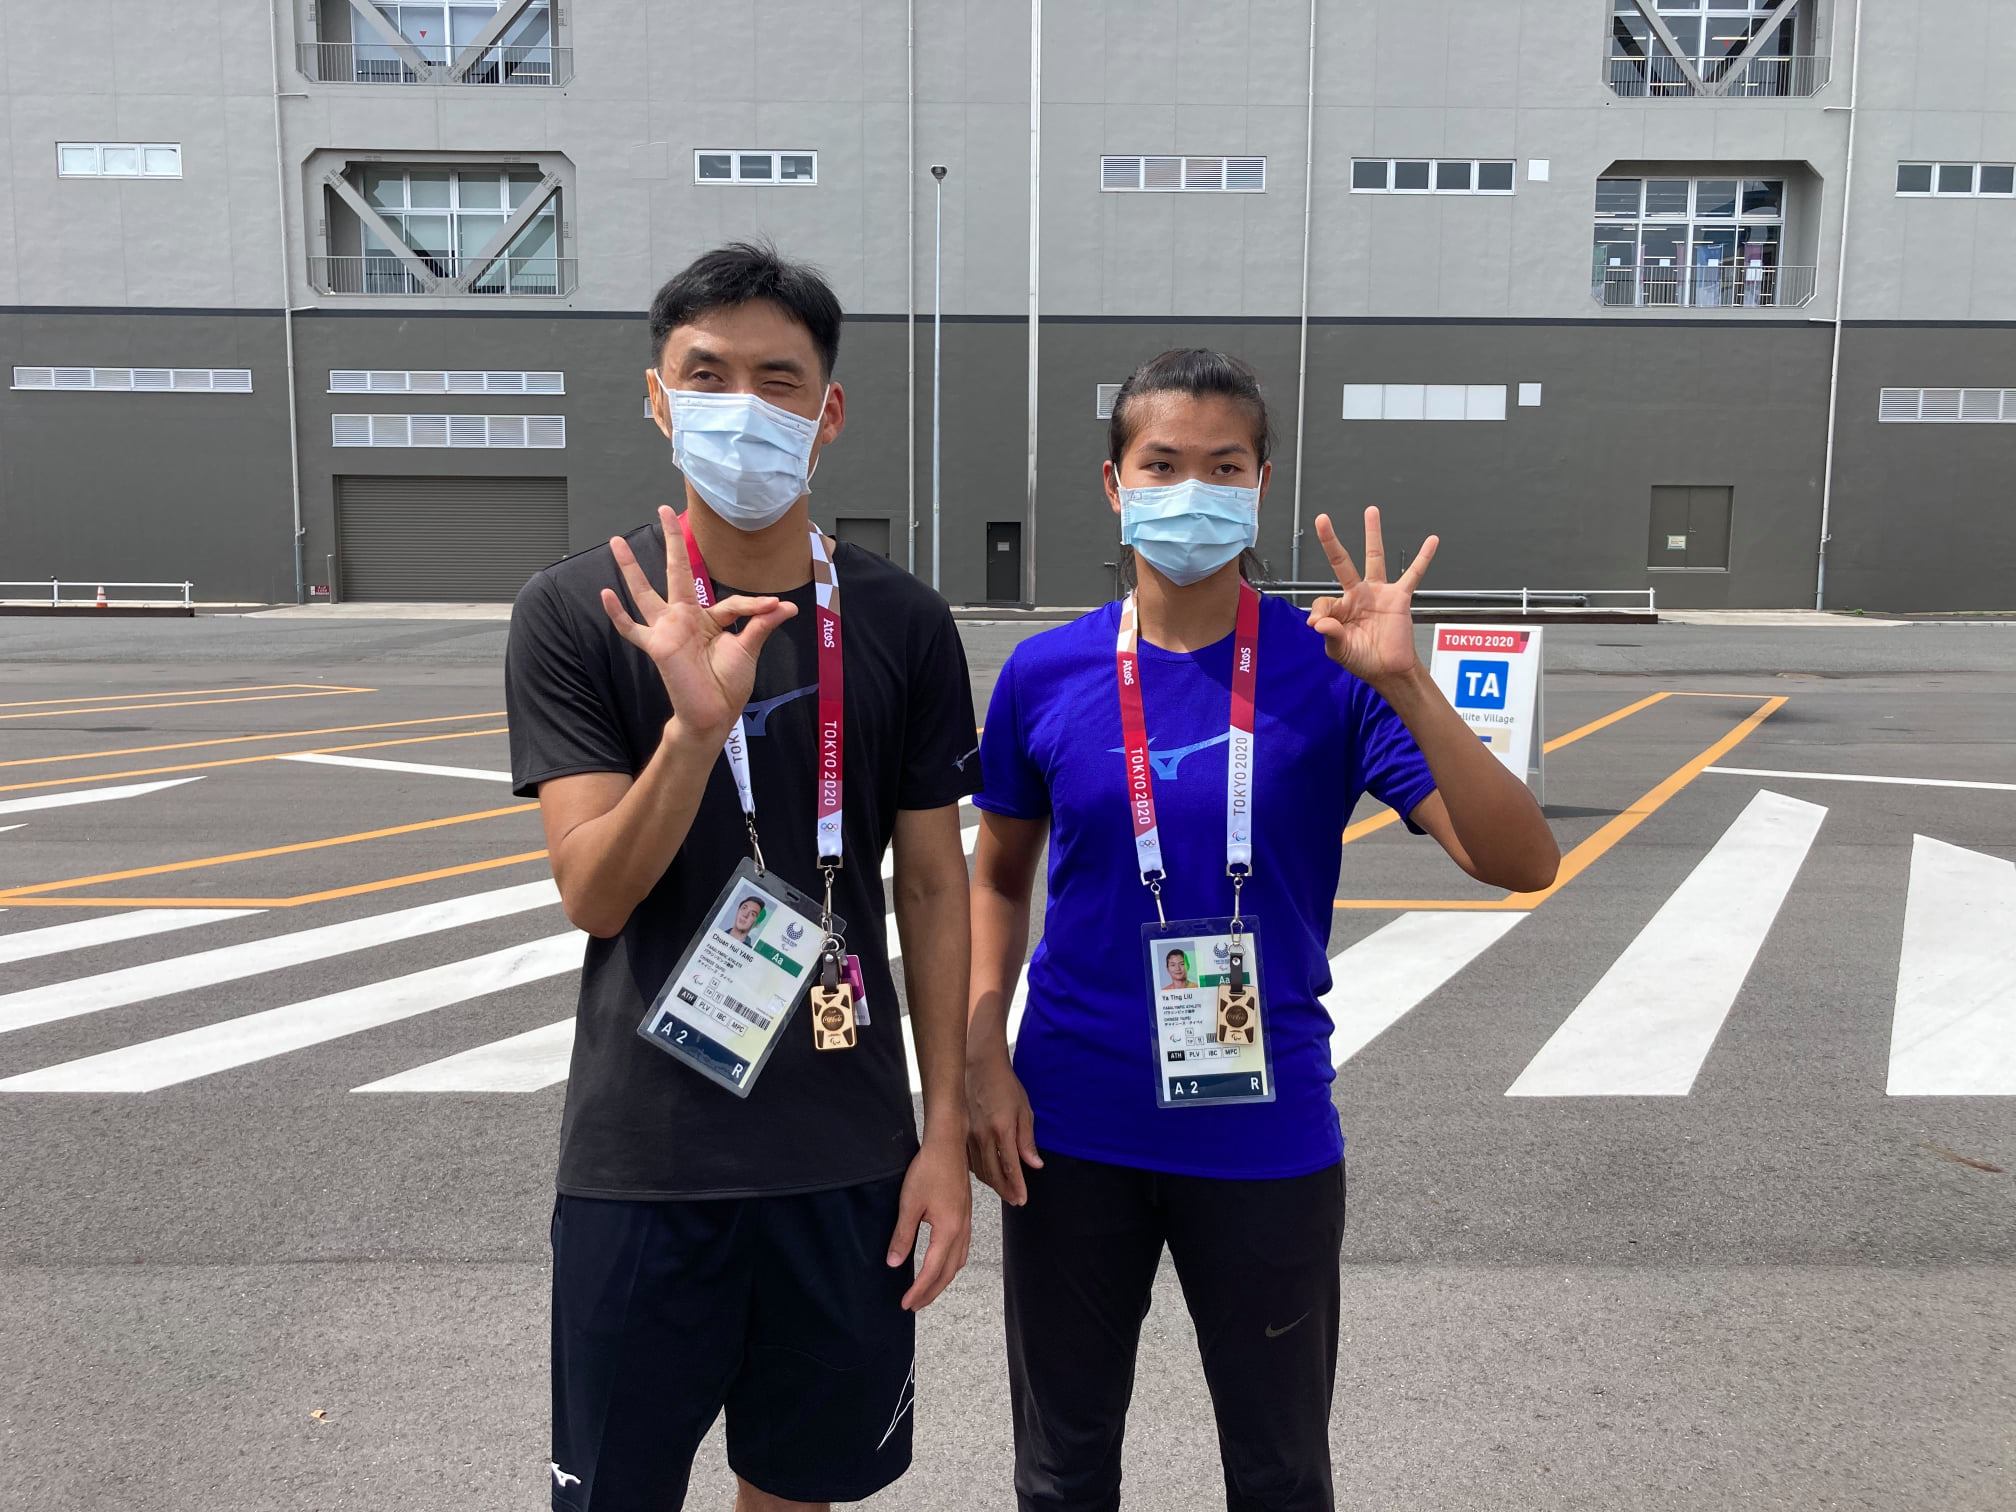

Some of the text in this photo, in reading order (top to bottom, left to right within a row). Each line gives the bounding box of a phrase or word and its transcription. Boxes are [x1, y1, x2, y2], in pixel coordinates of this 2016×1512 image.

[1445, 634, 1514, 647] TOKYO 2020
[1466, 672, 1500, 698] TA
[1460, 712, 1514, 724] llite Village
[824, 721, 837, 806] TOKYO 2020
[1233, 737, 1248, 816] TOKYO 2020
[1130, 748, 1151, 825] TOKYO 2020
[711, 932, 754, 962] Chuan Hui YANG
[771, 952, 784, 964] Aa
[680, 990, 744, 1033] ATH PLV IBC MPC
[661, 1022, 744, 1078] A 2 R
[1175, 1078, 1259, 1095] A 2 R
